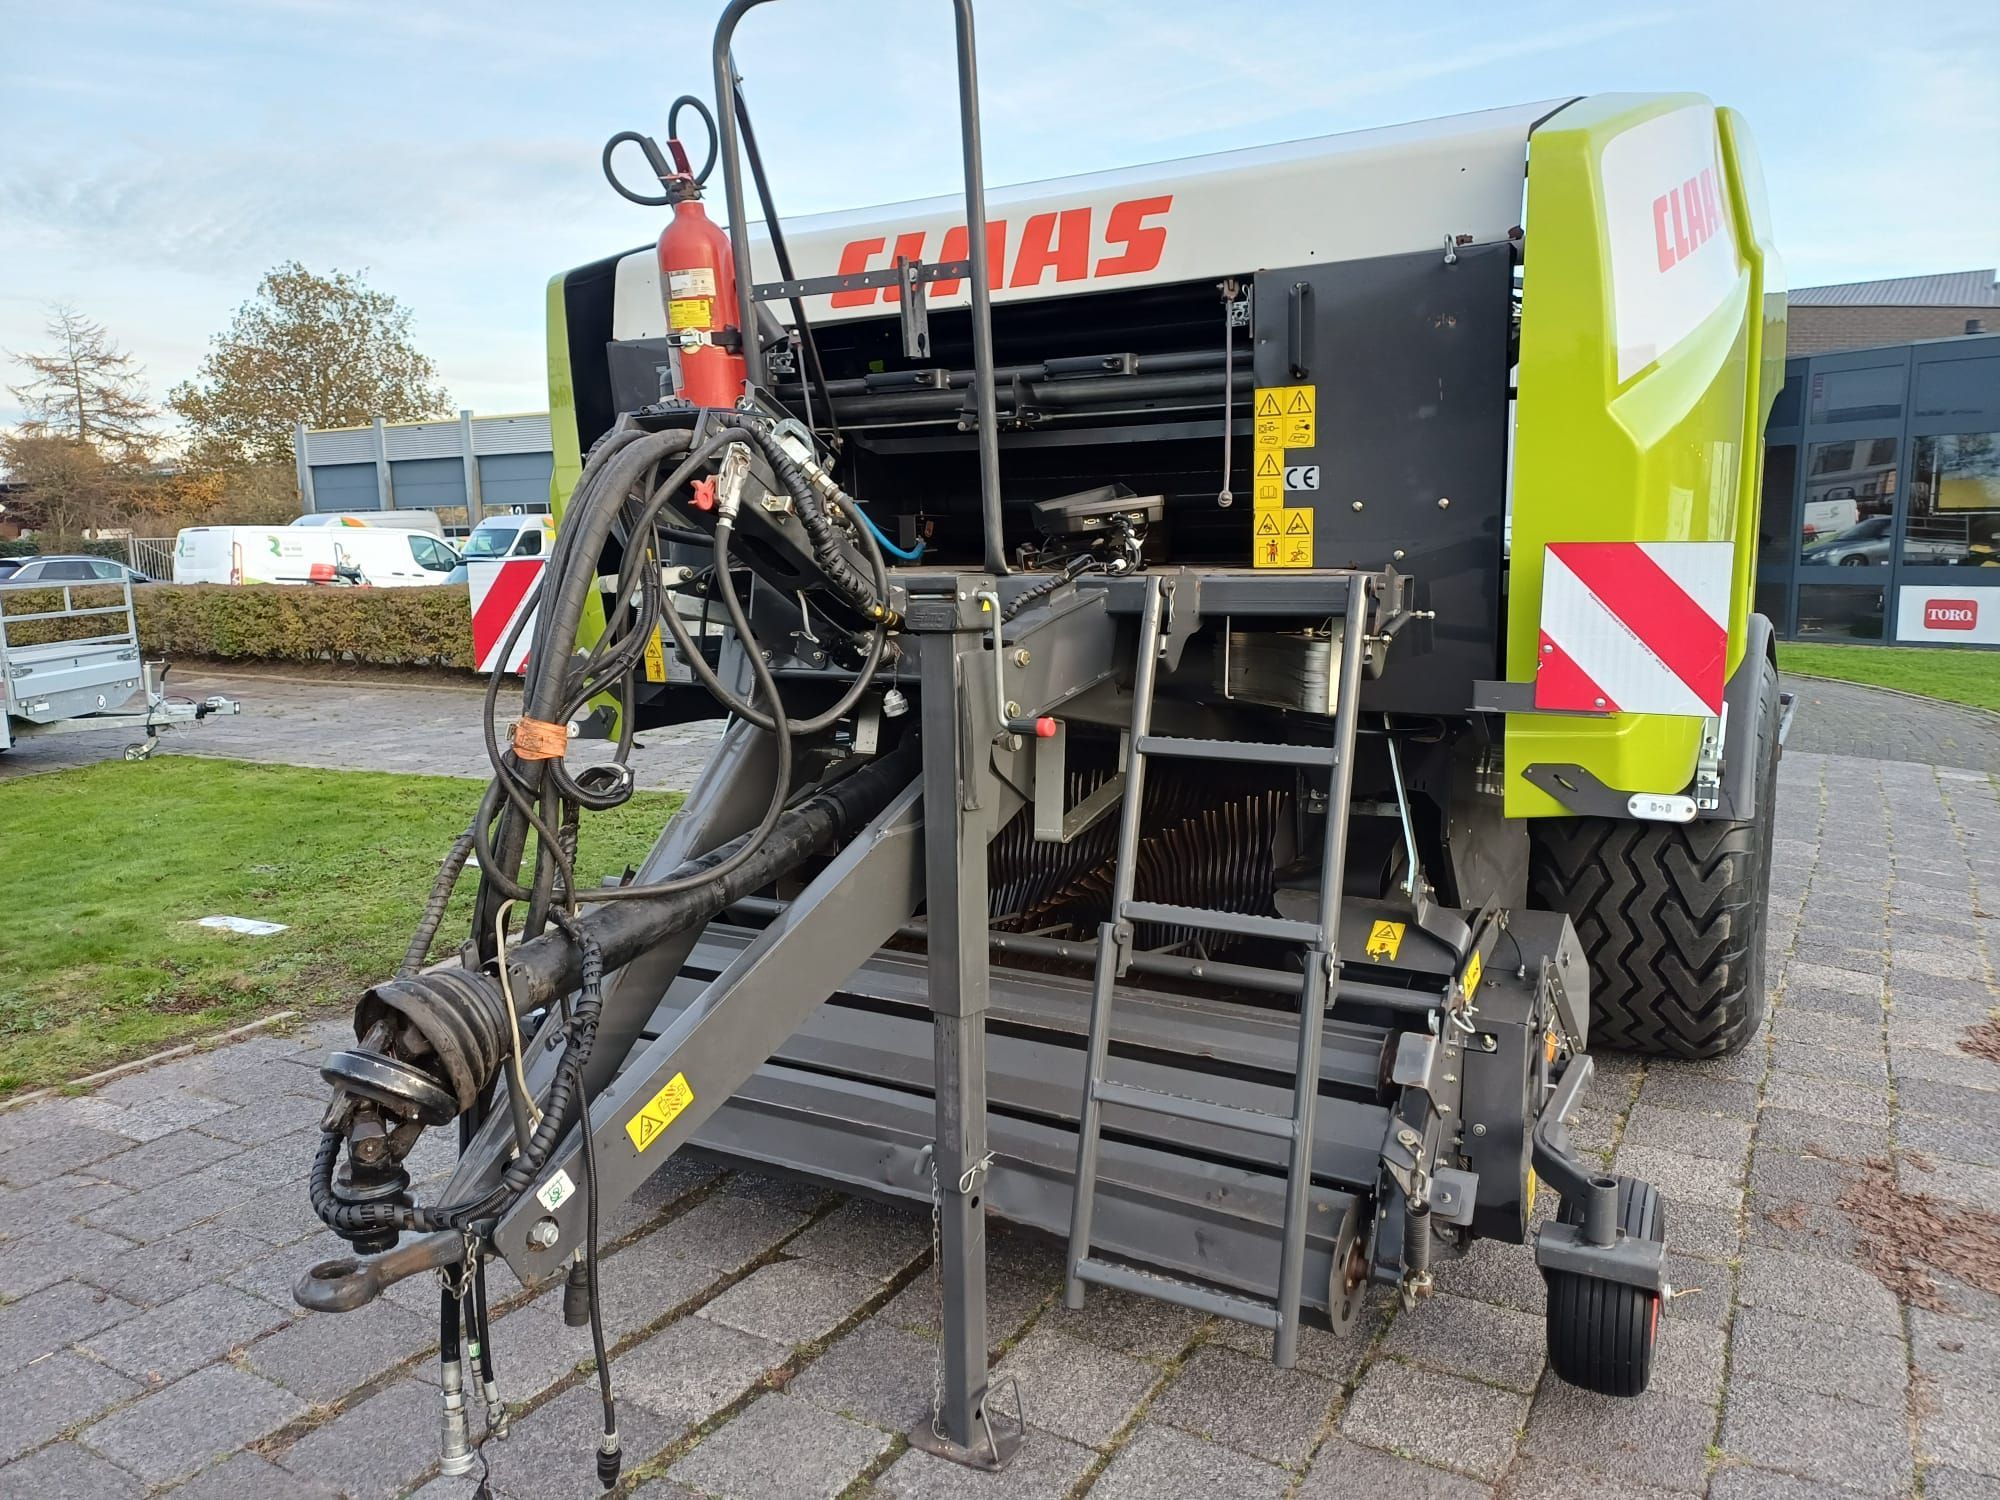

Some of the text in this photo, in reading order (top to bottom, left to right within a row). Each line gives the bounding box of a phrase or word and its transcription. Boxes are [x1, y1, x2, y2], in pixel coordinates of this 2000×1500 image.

[831, 194, 1173, 308] CLAAS
[1653, 165, 1720, 273] CLAA
[1286, 467, 1315, 489] CE
[1928, 608, 1972, 622] TORO
